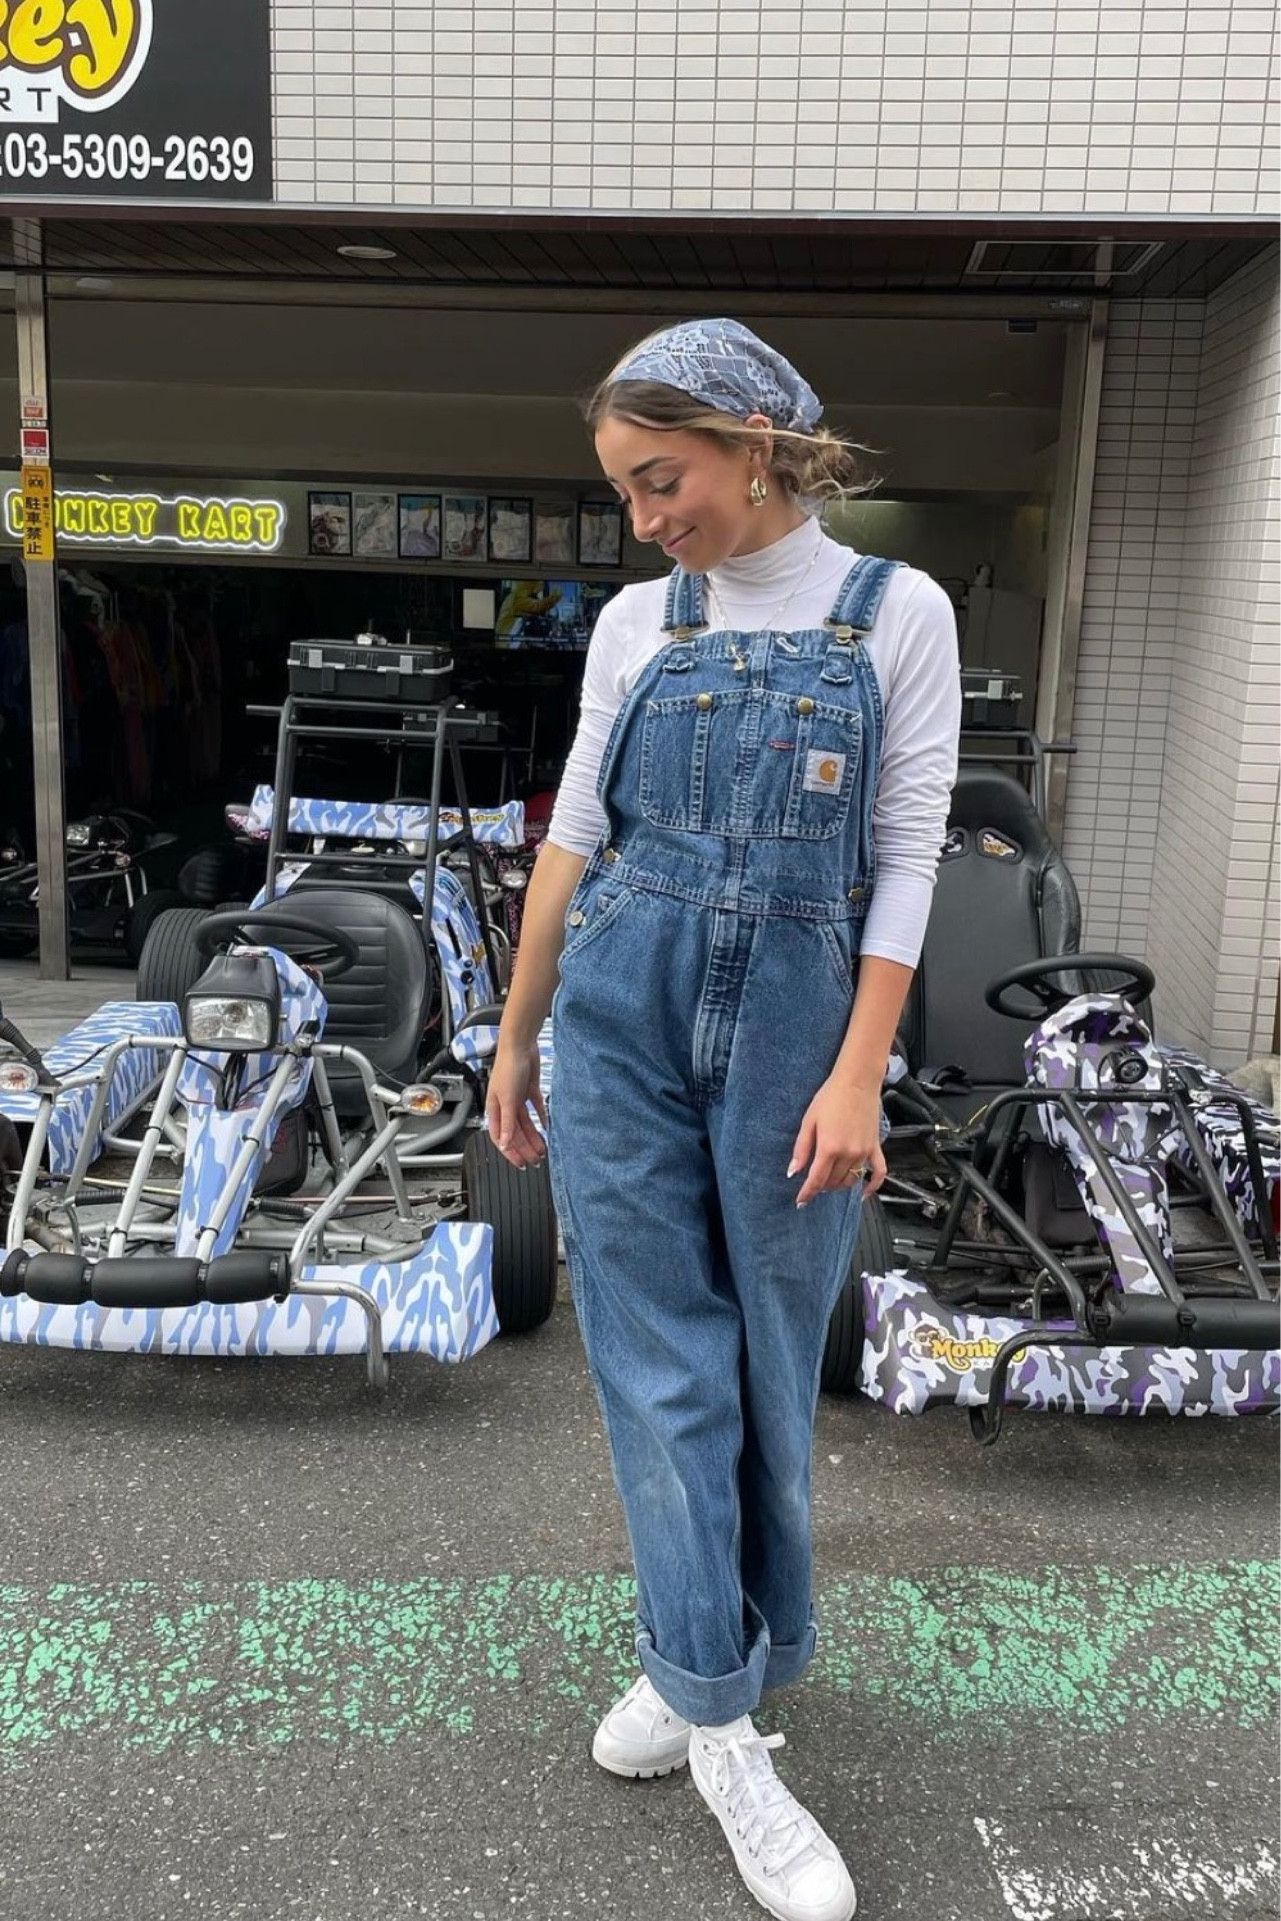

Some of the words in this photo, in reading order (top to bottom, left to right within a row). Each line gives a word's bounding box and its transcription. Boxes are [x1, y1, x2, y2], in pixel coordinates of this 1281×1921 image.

[0, 0, 135, 91] ey
[12, 496, 157, 535] MNKEY
[179, 504, 277, 543] KART
[26, 496, 43, 555] 駐車禁止
[932, 1339, 1026, 1371] Monk
